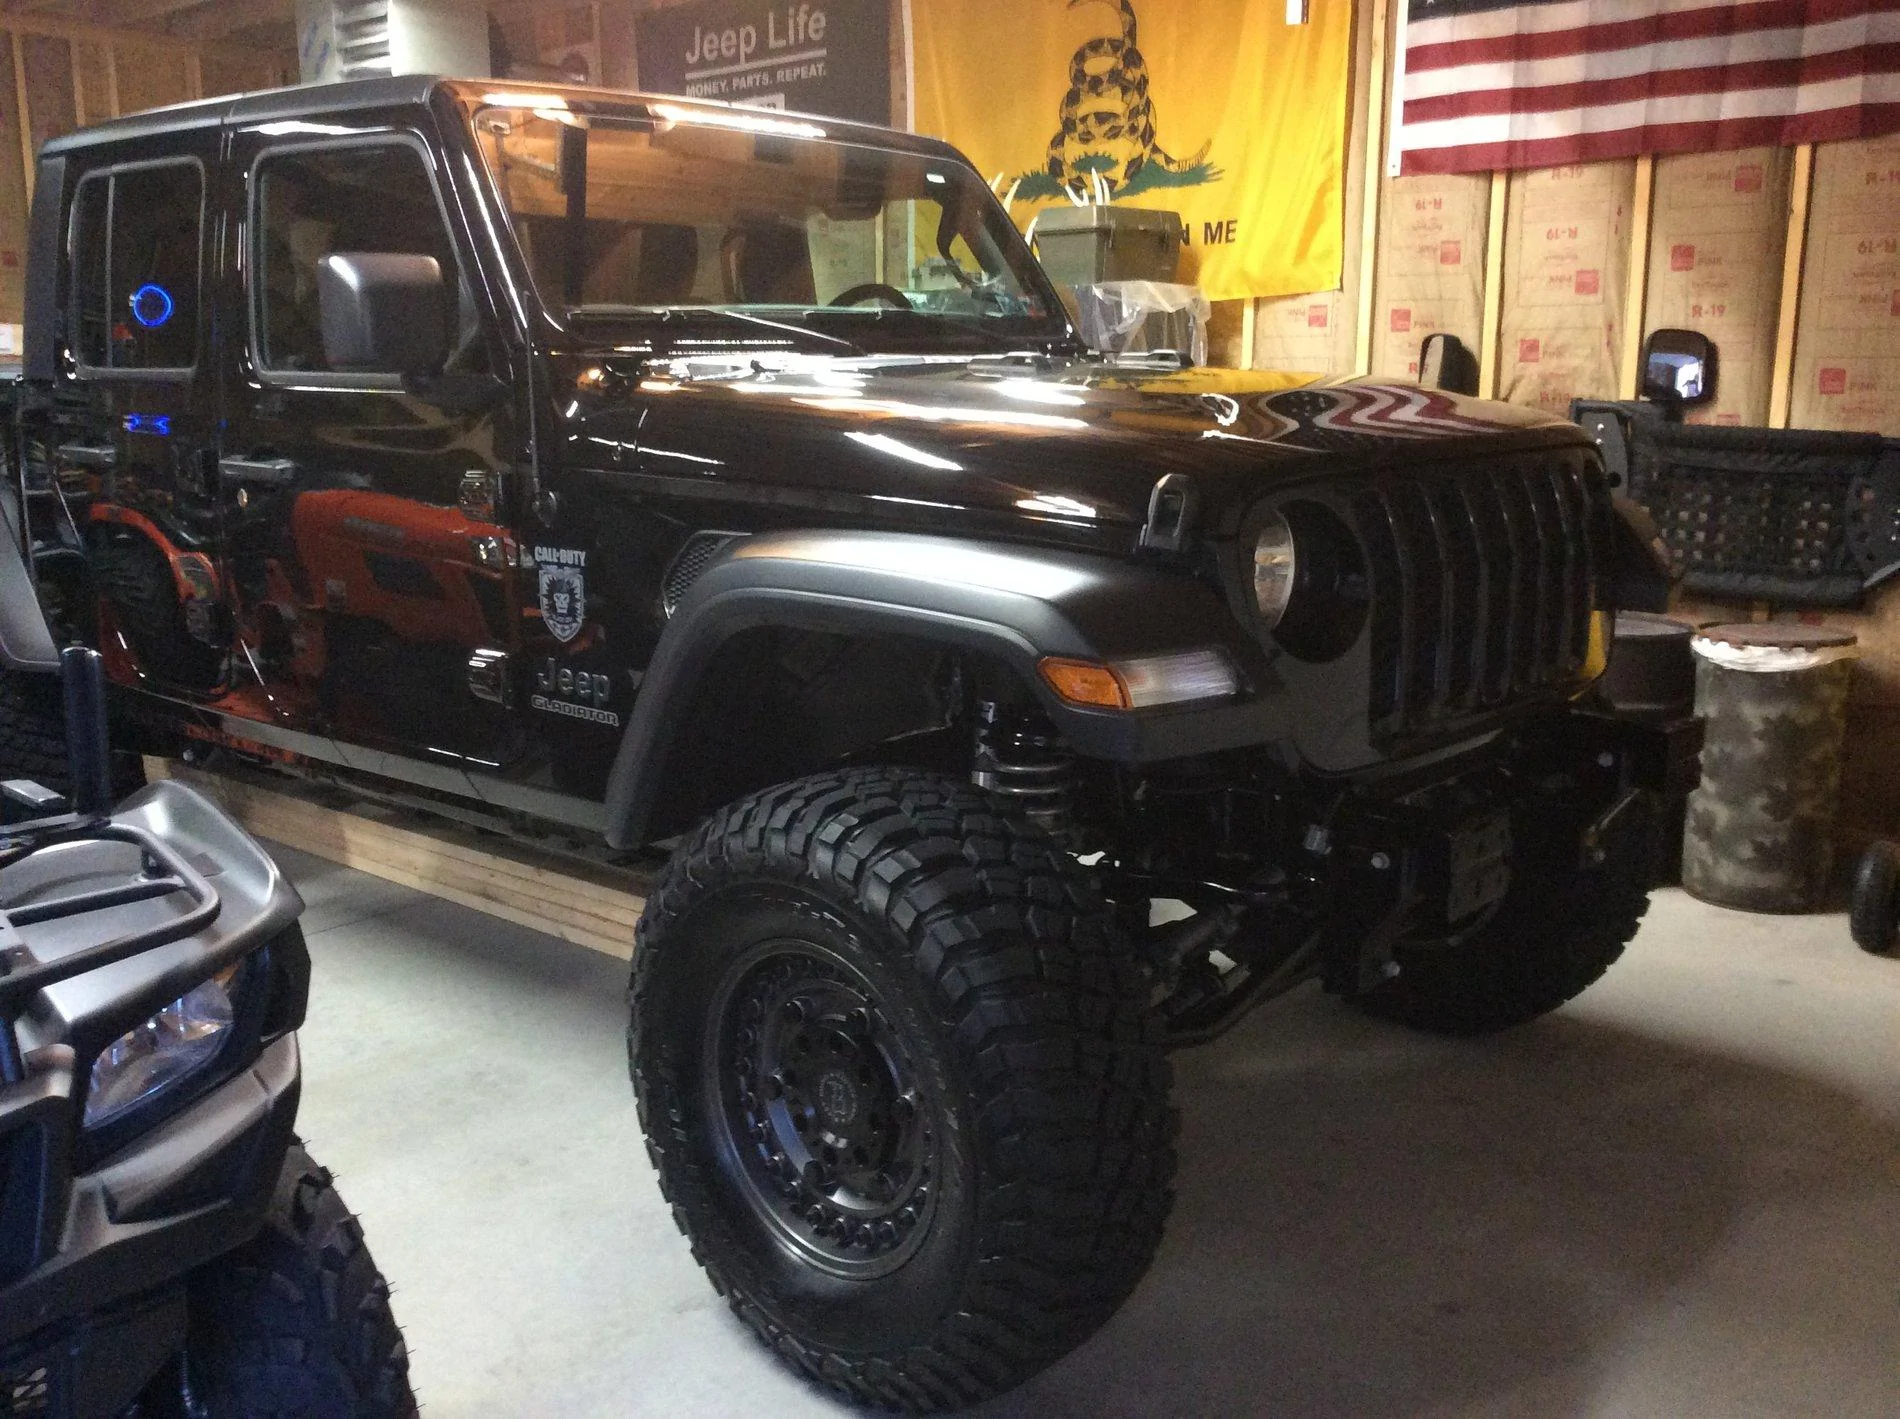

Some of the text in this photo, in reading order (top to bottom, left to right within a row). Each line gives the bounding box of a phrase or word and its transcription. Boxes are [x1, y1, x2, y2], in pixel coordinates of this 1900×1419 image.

[685, 4, 826, 64] Jeep Life
[686, 62, 826, 98] MONEY. PARTS. REPEAT.
[1203, 219, 1238, 246] ME
[1692, 304, 1727, 319] R-19
[535, 546, 586, 567] CALL DUTY
[537, 656, 610, 705] Jeep
[531, 694, 619, 727] GLADIATOR
